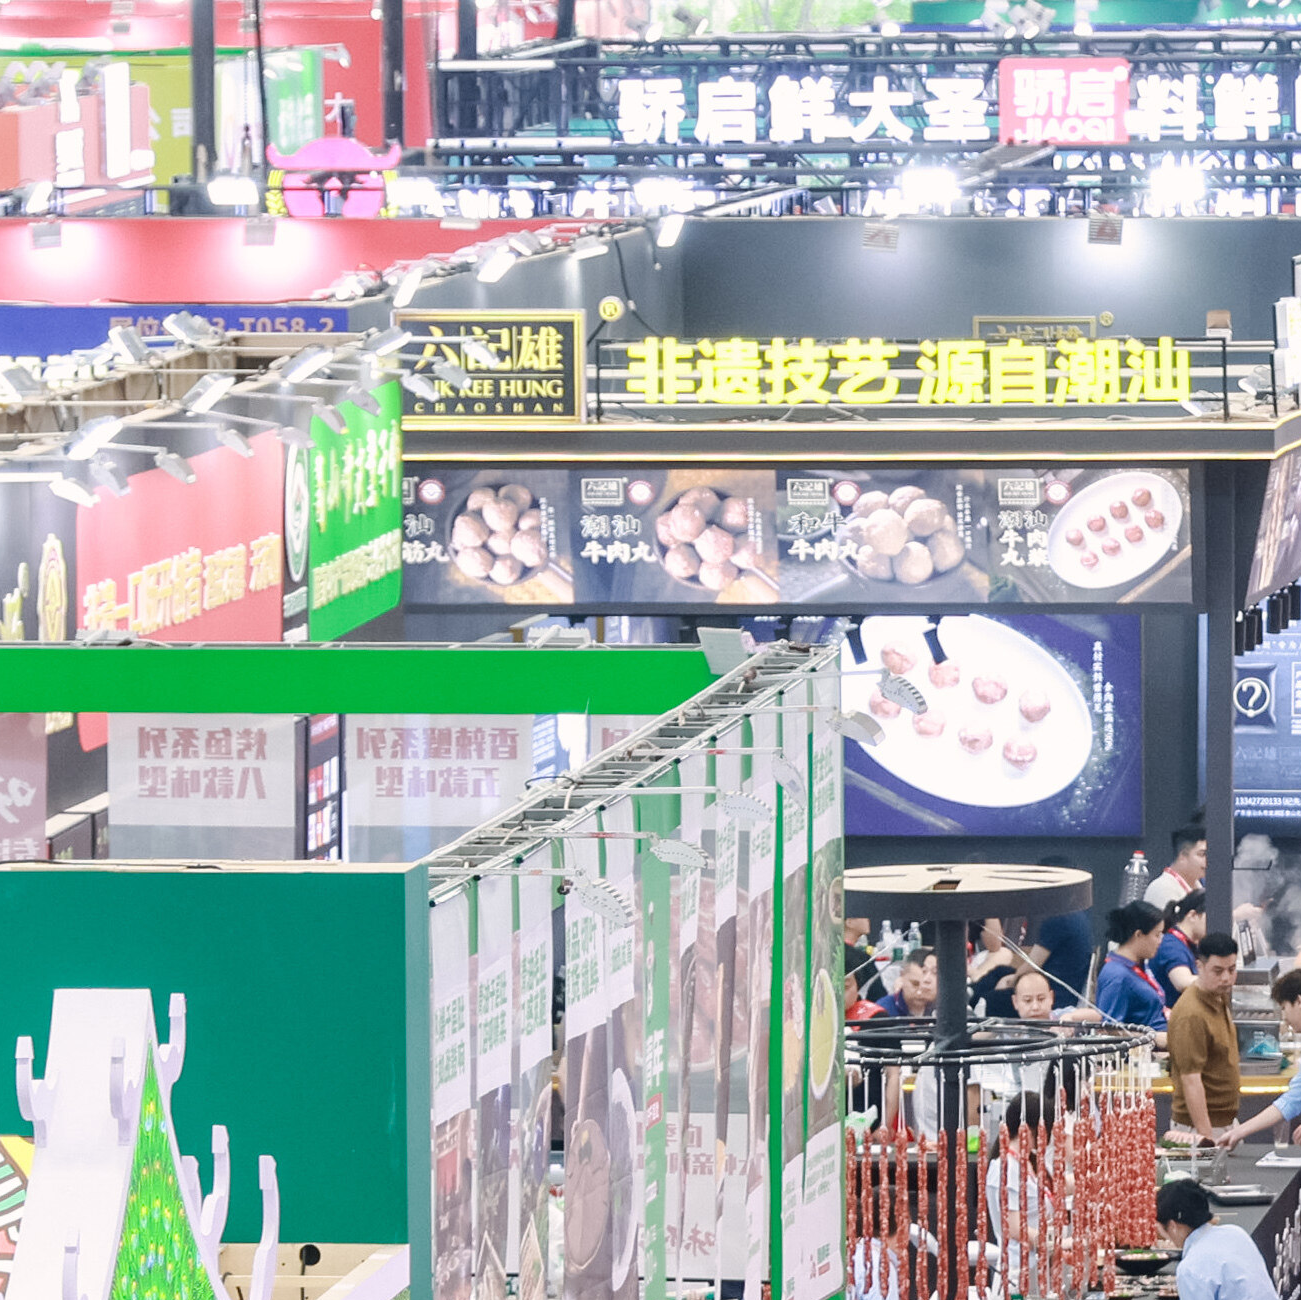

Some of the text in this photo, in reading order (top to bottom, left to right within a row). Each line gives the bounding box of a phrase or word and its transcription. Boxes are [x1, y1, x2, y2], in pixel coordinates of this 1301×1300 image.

[626, 336, 1191, 406] 非遗技艺 源自潮汕
[501, 379, 564, 398] HUNG
[580, 541, 658, 564] 牛肉丸
